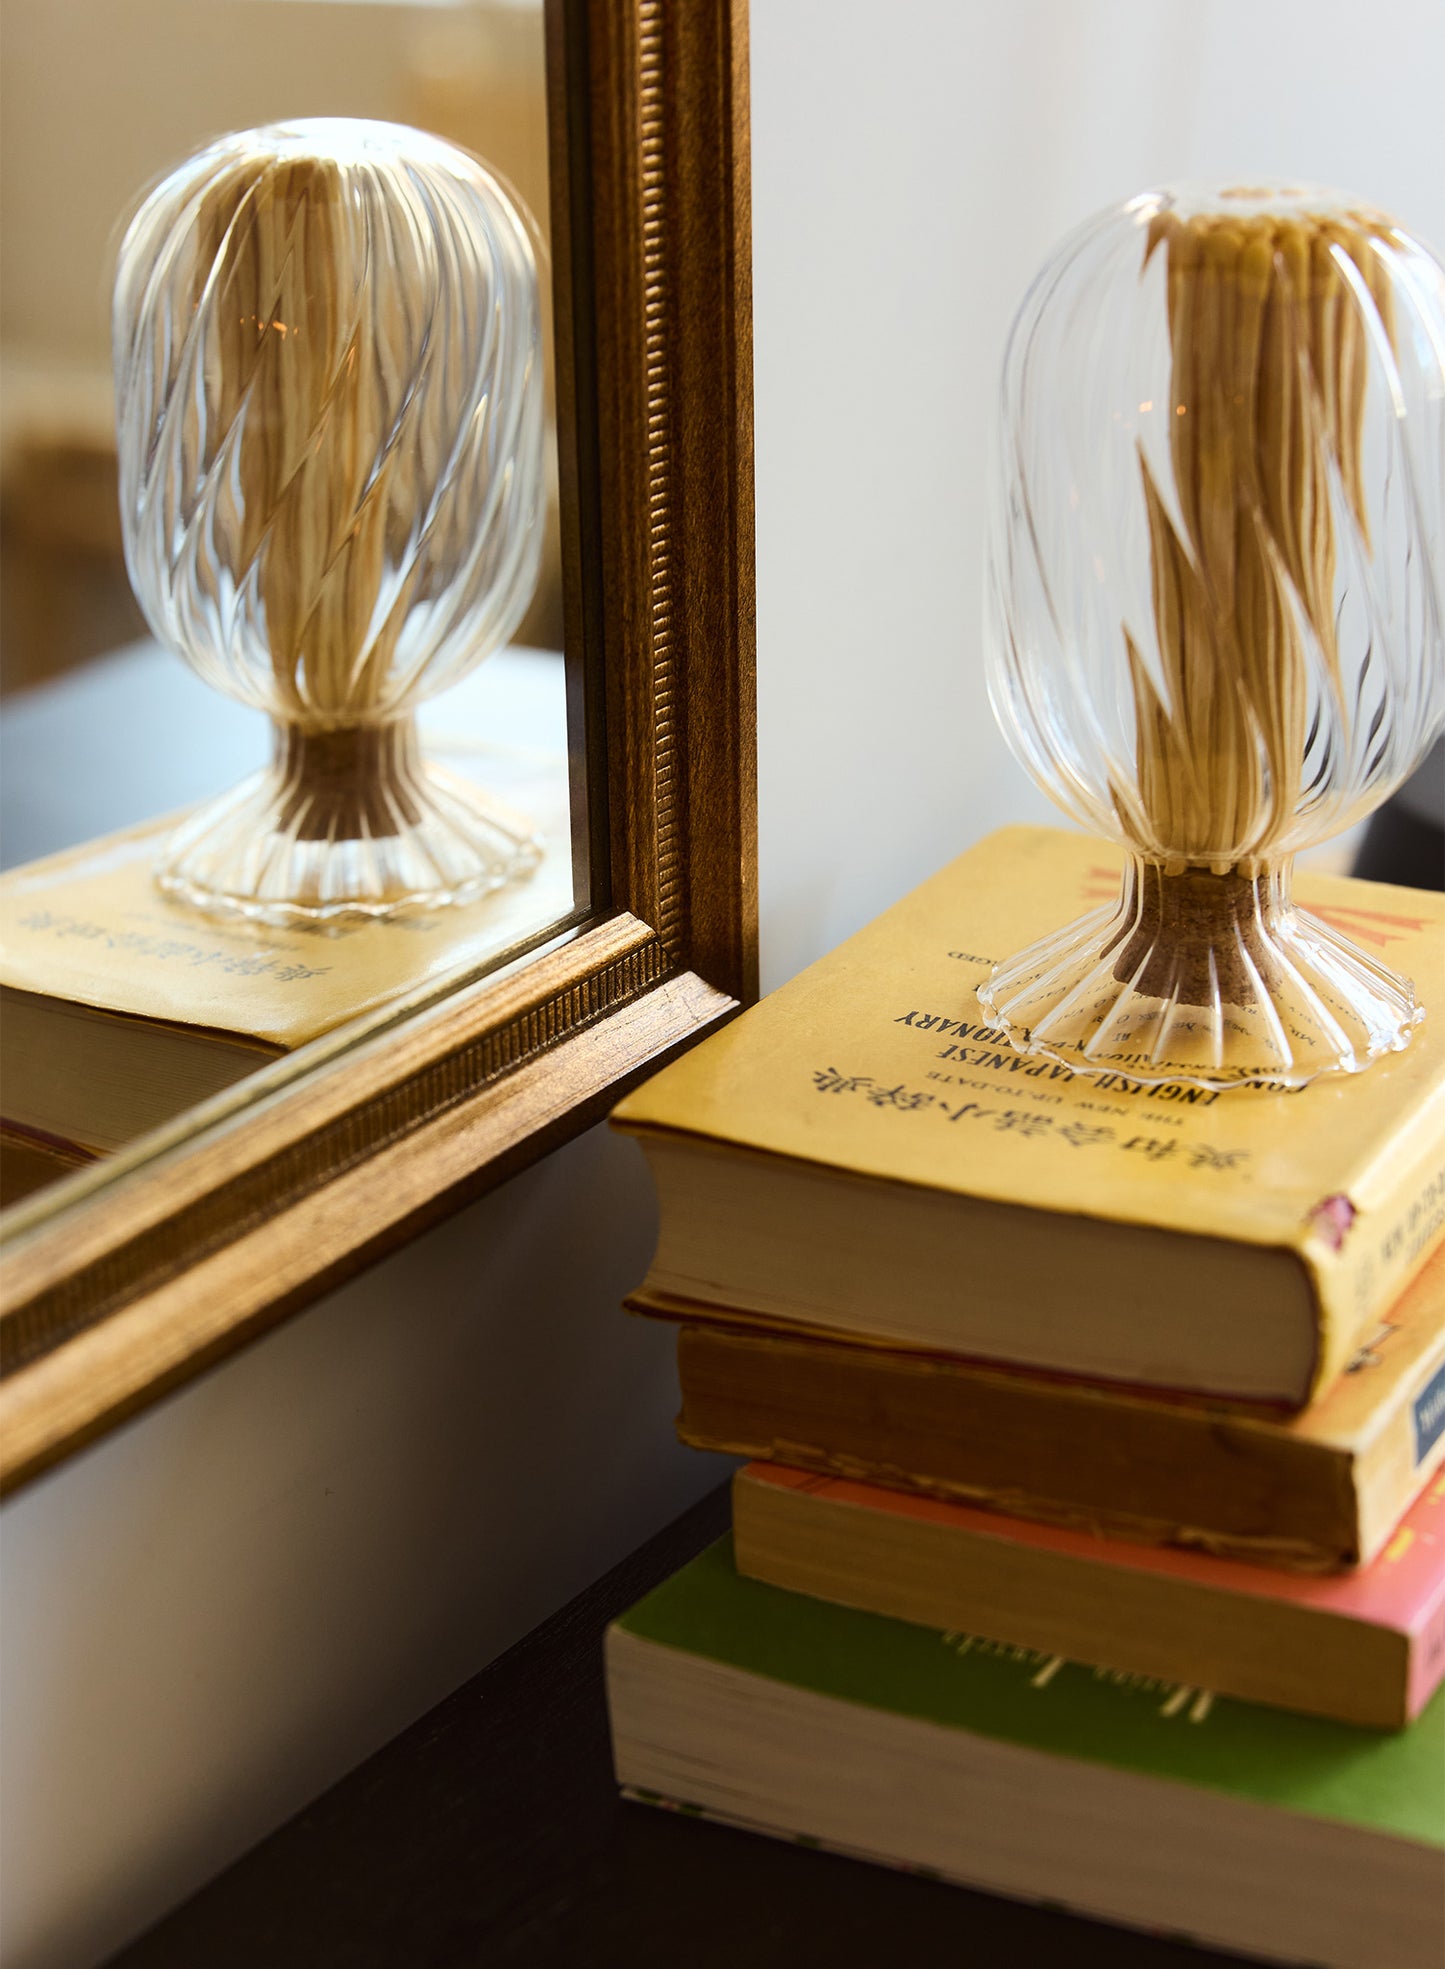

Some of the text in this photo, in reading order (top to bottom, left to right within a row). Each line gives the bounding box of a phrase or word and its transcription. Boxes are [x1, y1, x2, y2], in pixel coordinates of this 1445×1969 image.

[936, 1042, 1220, 1108] ENGLISH-JAPANESE
[1078, 1099, 1130, 1119] NEW
[1150, 1108, 1184, 1126] THE
